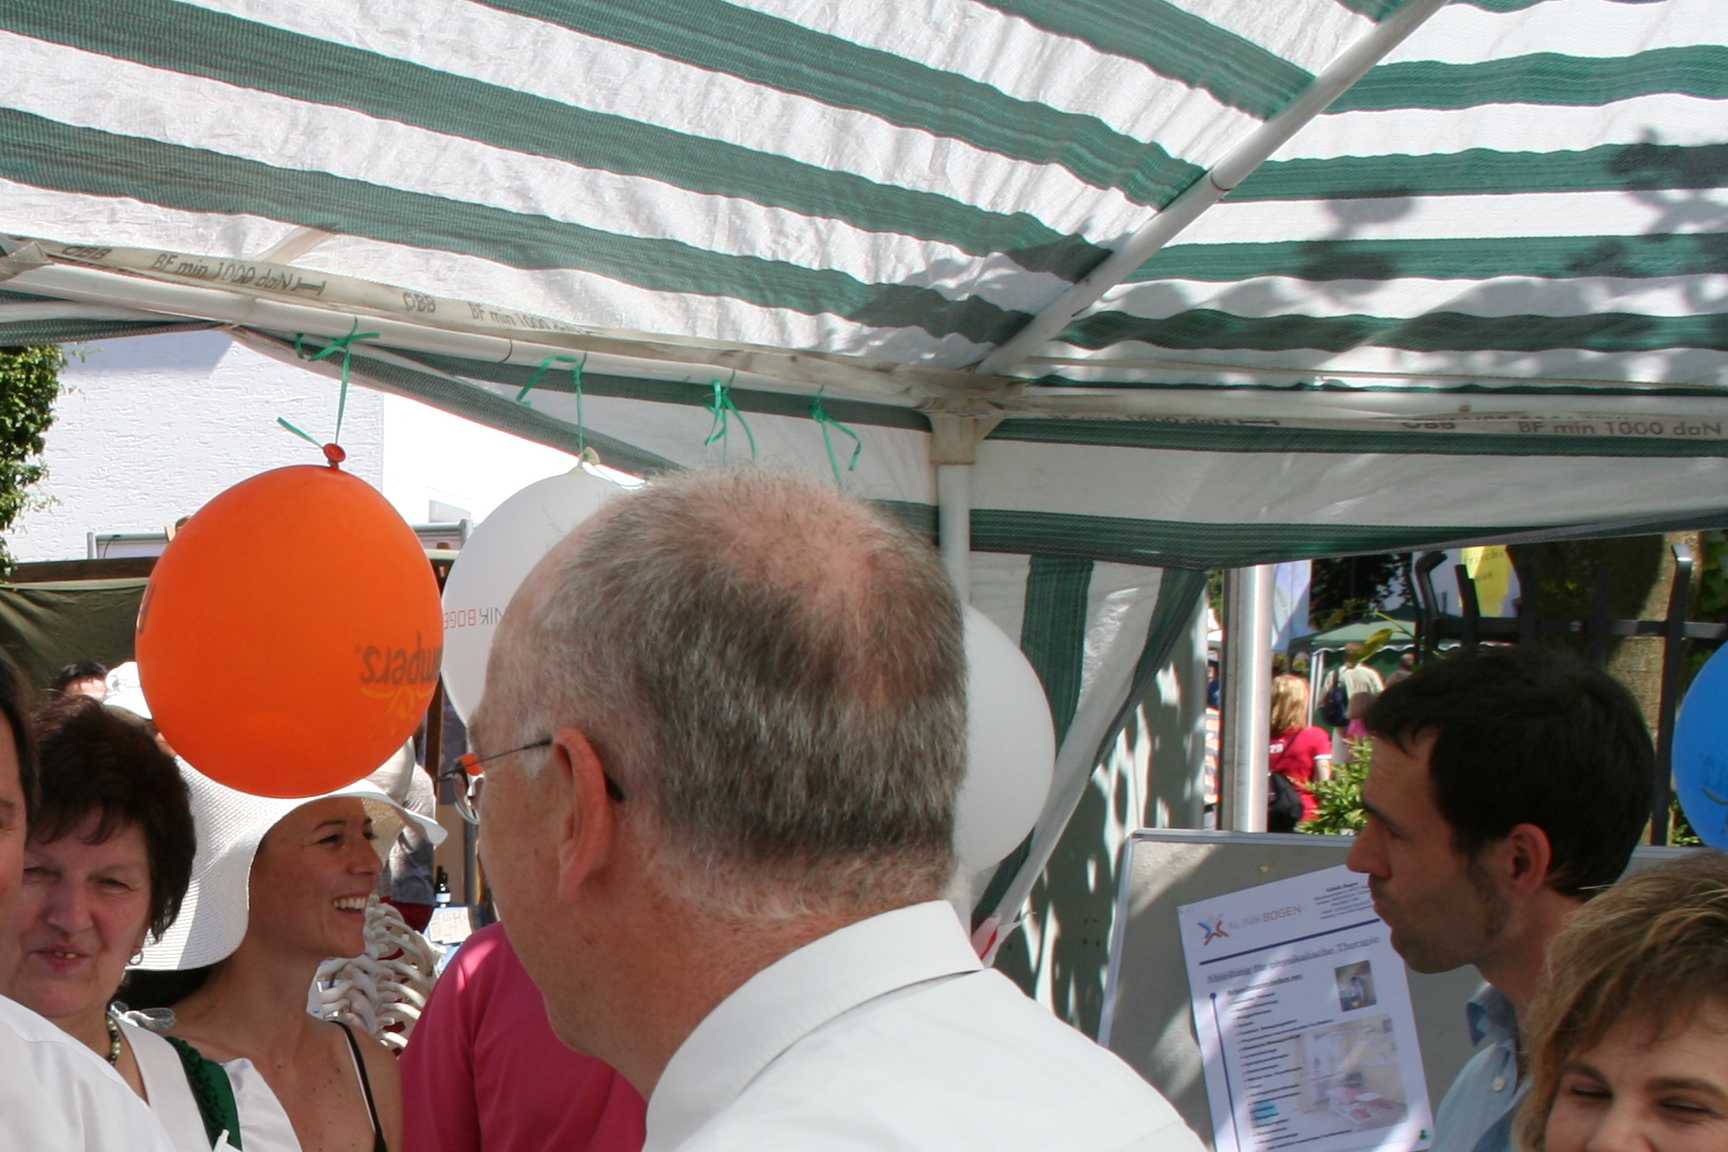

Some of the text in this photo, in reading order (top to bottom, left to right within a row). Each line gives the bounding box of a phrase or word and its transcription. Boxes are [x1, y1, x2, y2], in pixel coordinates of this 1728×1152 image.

[178, 259, 210, 276] min
[214, 262, 256, 283] 1000
[1553, 421, 1595, 435] min
[1605, 421, 1664, 436] 1000
[1673, 421, 1721, 437] daN
